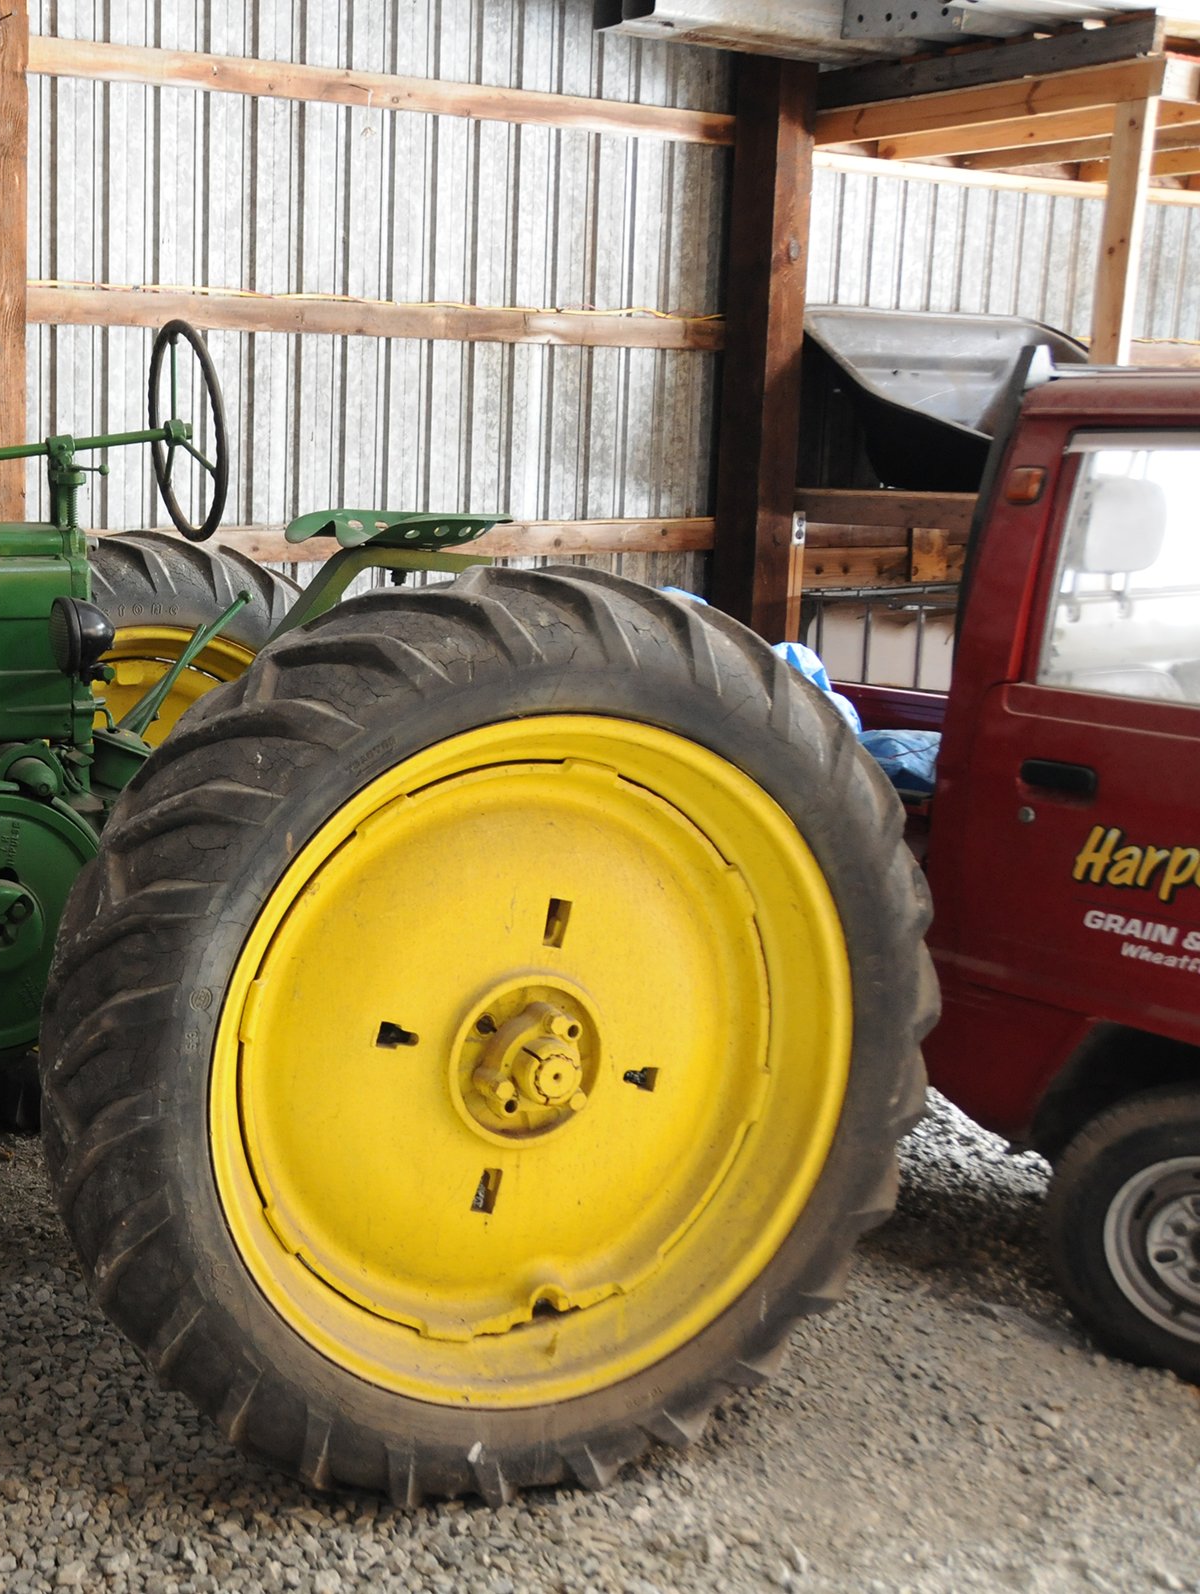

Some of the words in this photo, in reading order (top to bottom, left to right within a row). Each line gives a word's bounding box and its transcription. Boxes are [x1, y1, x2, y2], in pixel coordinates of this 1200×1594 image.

[1071, 825, 1200, 903] Harp
[1083, 910, 1178, 946] GRAIN
[1182, 931, 1200, 952] &
